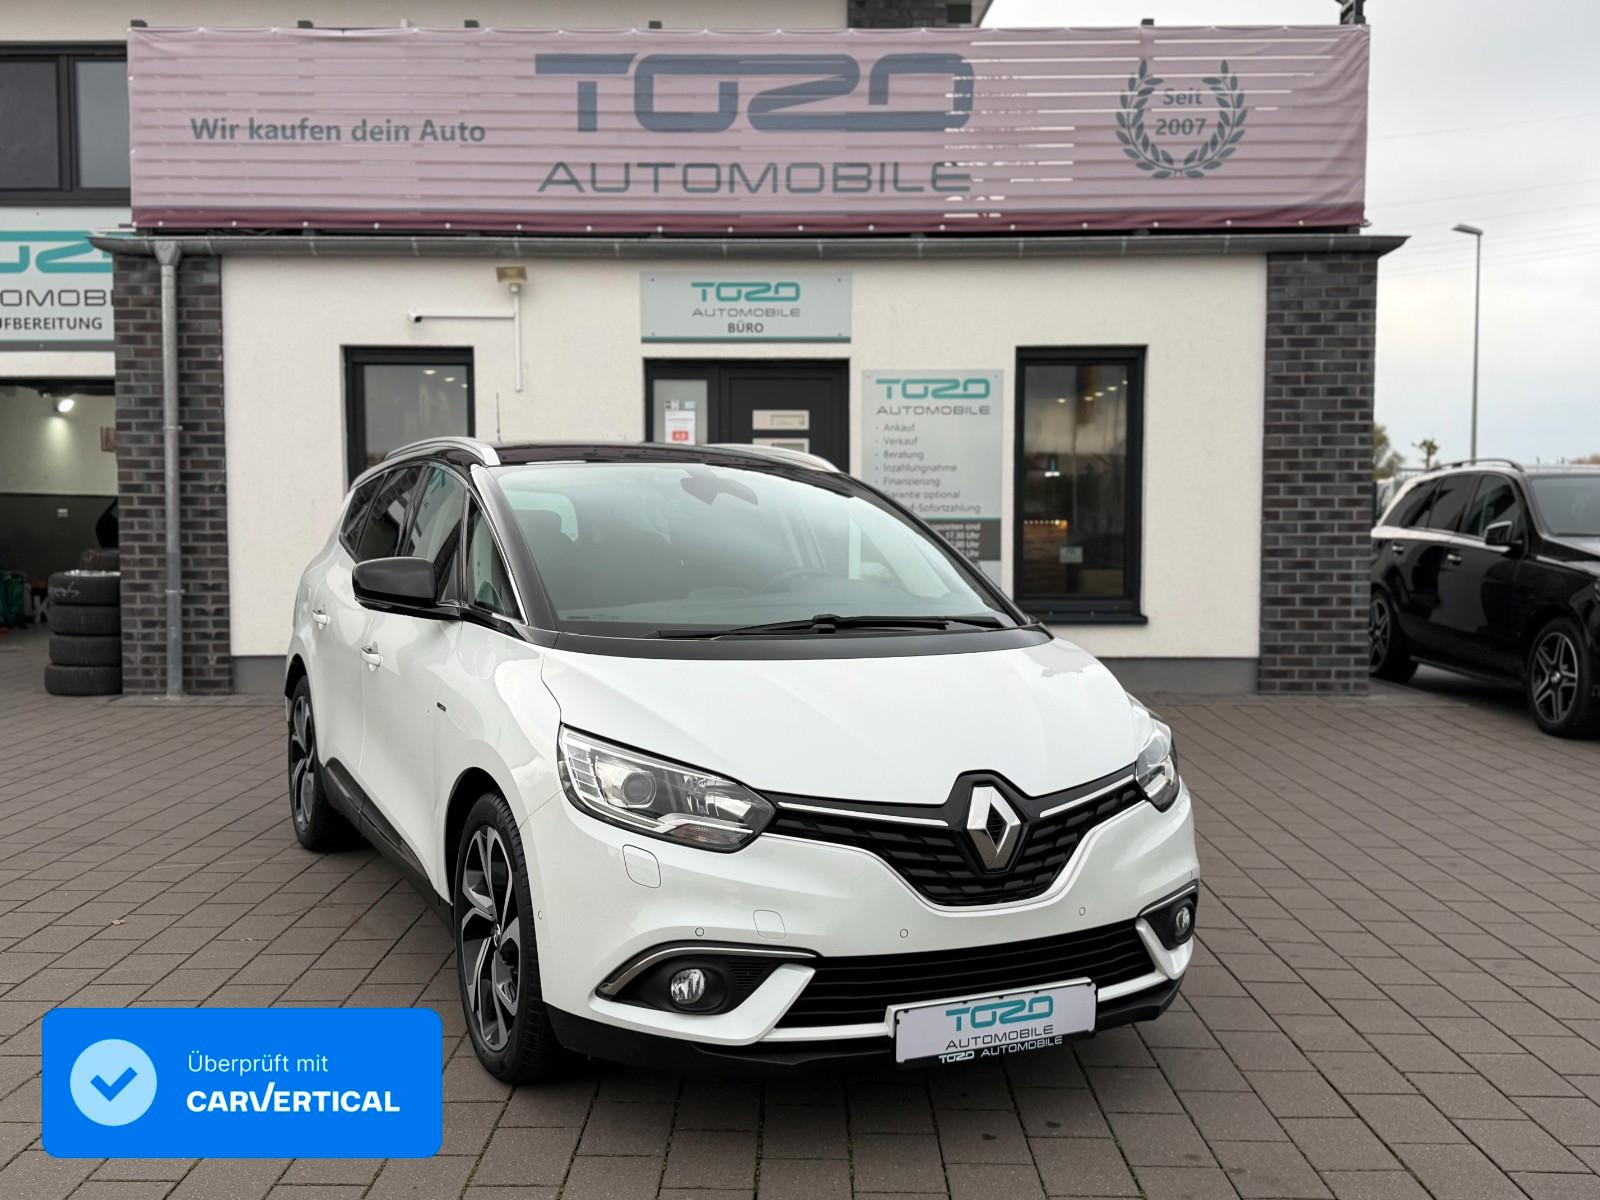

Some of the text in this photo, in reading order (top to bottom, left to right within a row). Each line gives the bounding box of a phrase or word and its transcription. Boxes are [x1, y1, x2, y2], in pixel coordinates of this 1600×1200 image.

[1162, 87, 1203, 105] Seit
[190, 117, 486, 142] Wir kaufen dein Auto
[1155, 118, 1207, 135] 2007
[538, 161, 971, 194] AUTOMOBILE
[691, 282, 801, 302] TOZO
[691, 307, 801, 318] AUTOMOBILE
[0, 317, 103, 330] FBEREITUNG
[727, 319, 765, 334] BÜRO
[875, 378, 991, 399] TOZO
[876, 405, 991, 416] AUTOMOBILE
[883, 423, 915, 432] Ankauf
[883, 437, 918, 446] Verkauf
[883, 451, 924, 460] Beratung
[883, 464, 957, 474] Inzahlungnahme
[883, 477, 940, 487] Finanzierung
[923, 489, 960, 500] optional
[907, 503, 981, 514] d-Sofortzahlung
[966, 531, 980, 540] Uhr
[966, 540, 980, 549] Uhr
[945, 995, 1054, 1032] TOZO
[946, 1024, 1054, 1051] AUTOMOBILE
[980, 1035, 1063, 1057] AUTOMOBILE
